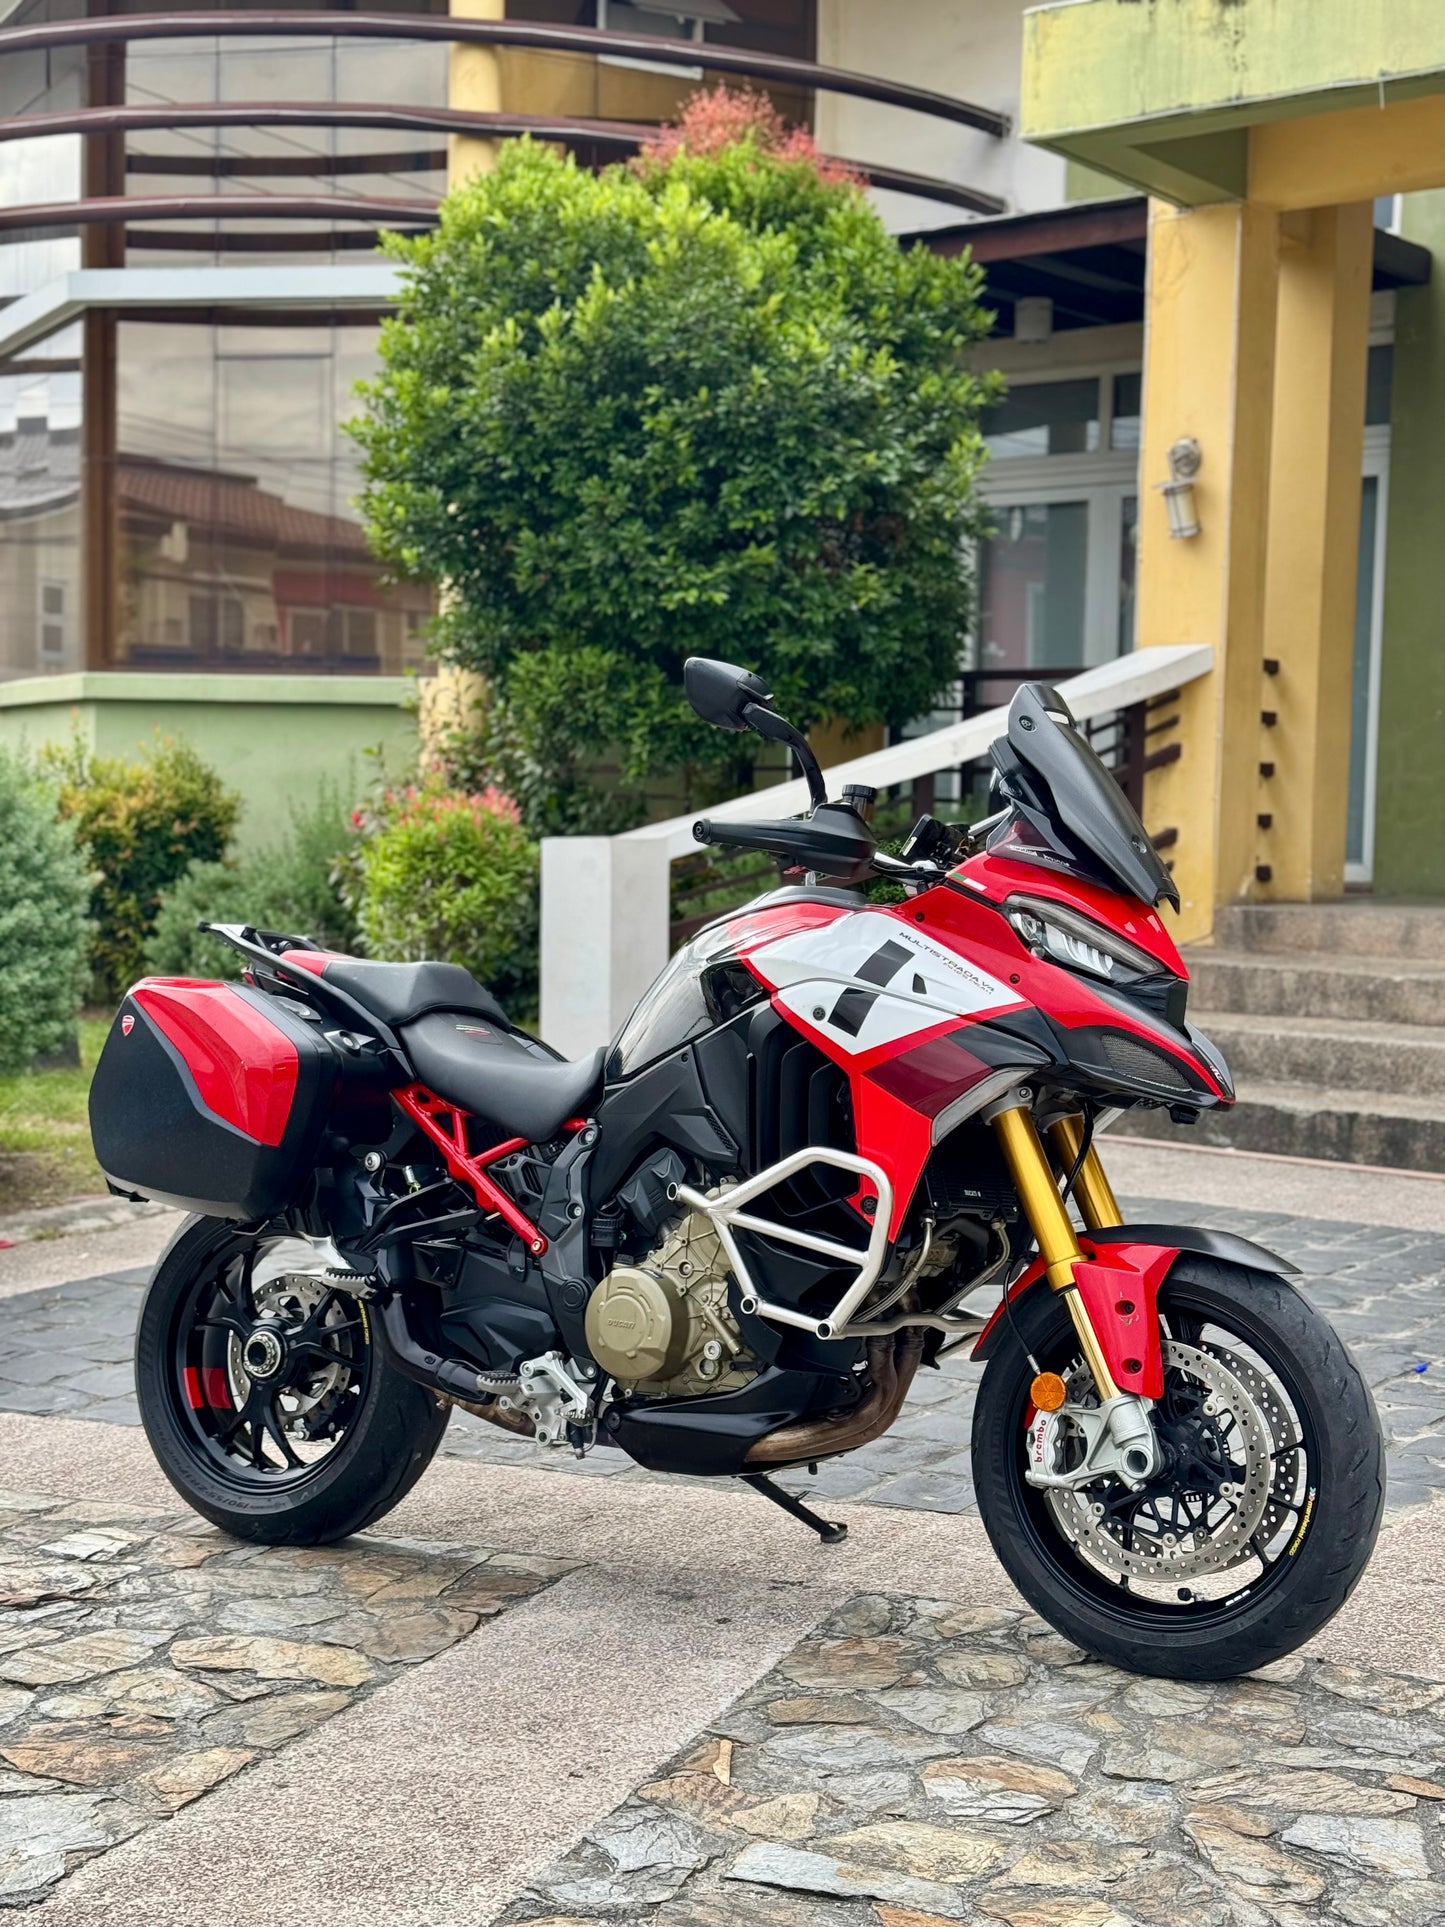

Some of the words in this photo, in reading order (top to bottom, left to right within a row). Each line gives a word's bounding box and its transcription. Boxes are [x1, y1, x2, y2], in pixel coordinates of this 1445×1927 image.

[899, 932, 979, 983] MULTISTRADA
[607, 1318, 636, 1330] DUCATI
[1034, 1419, 1047, 1463] brembo
